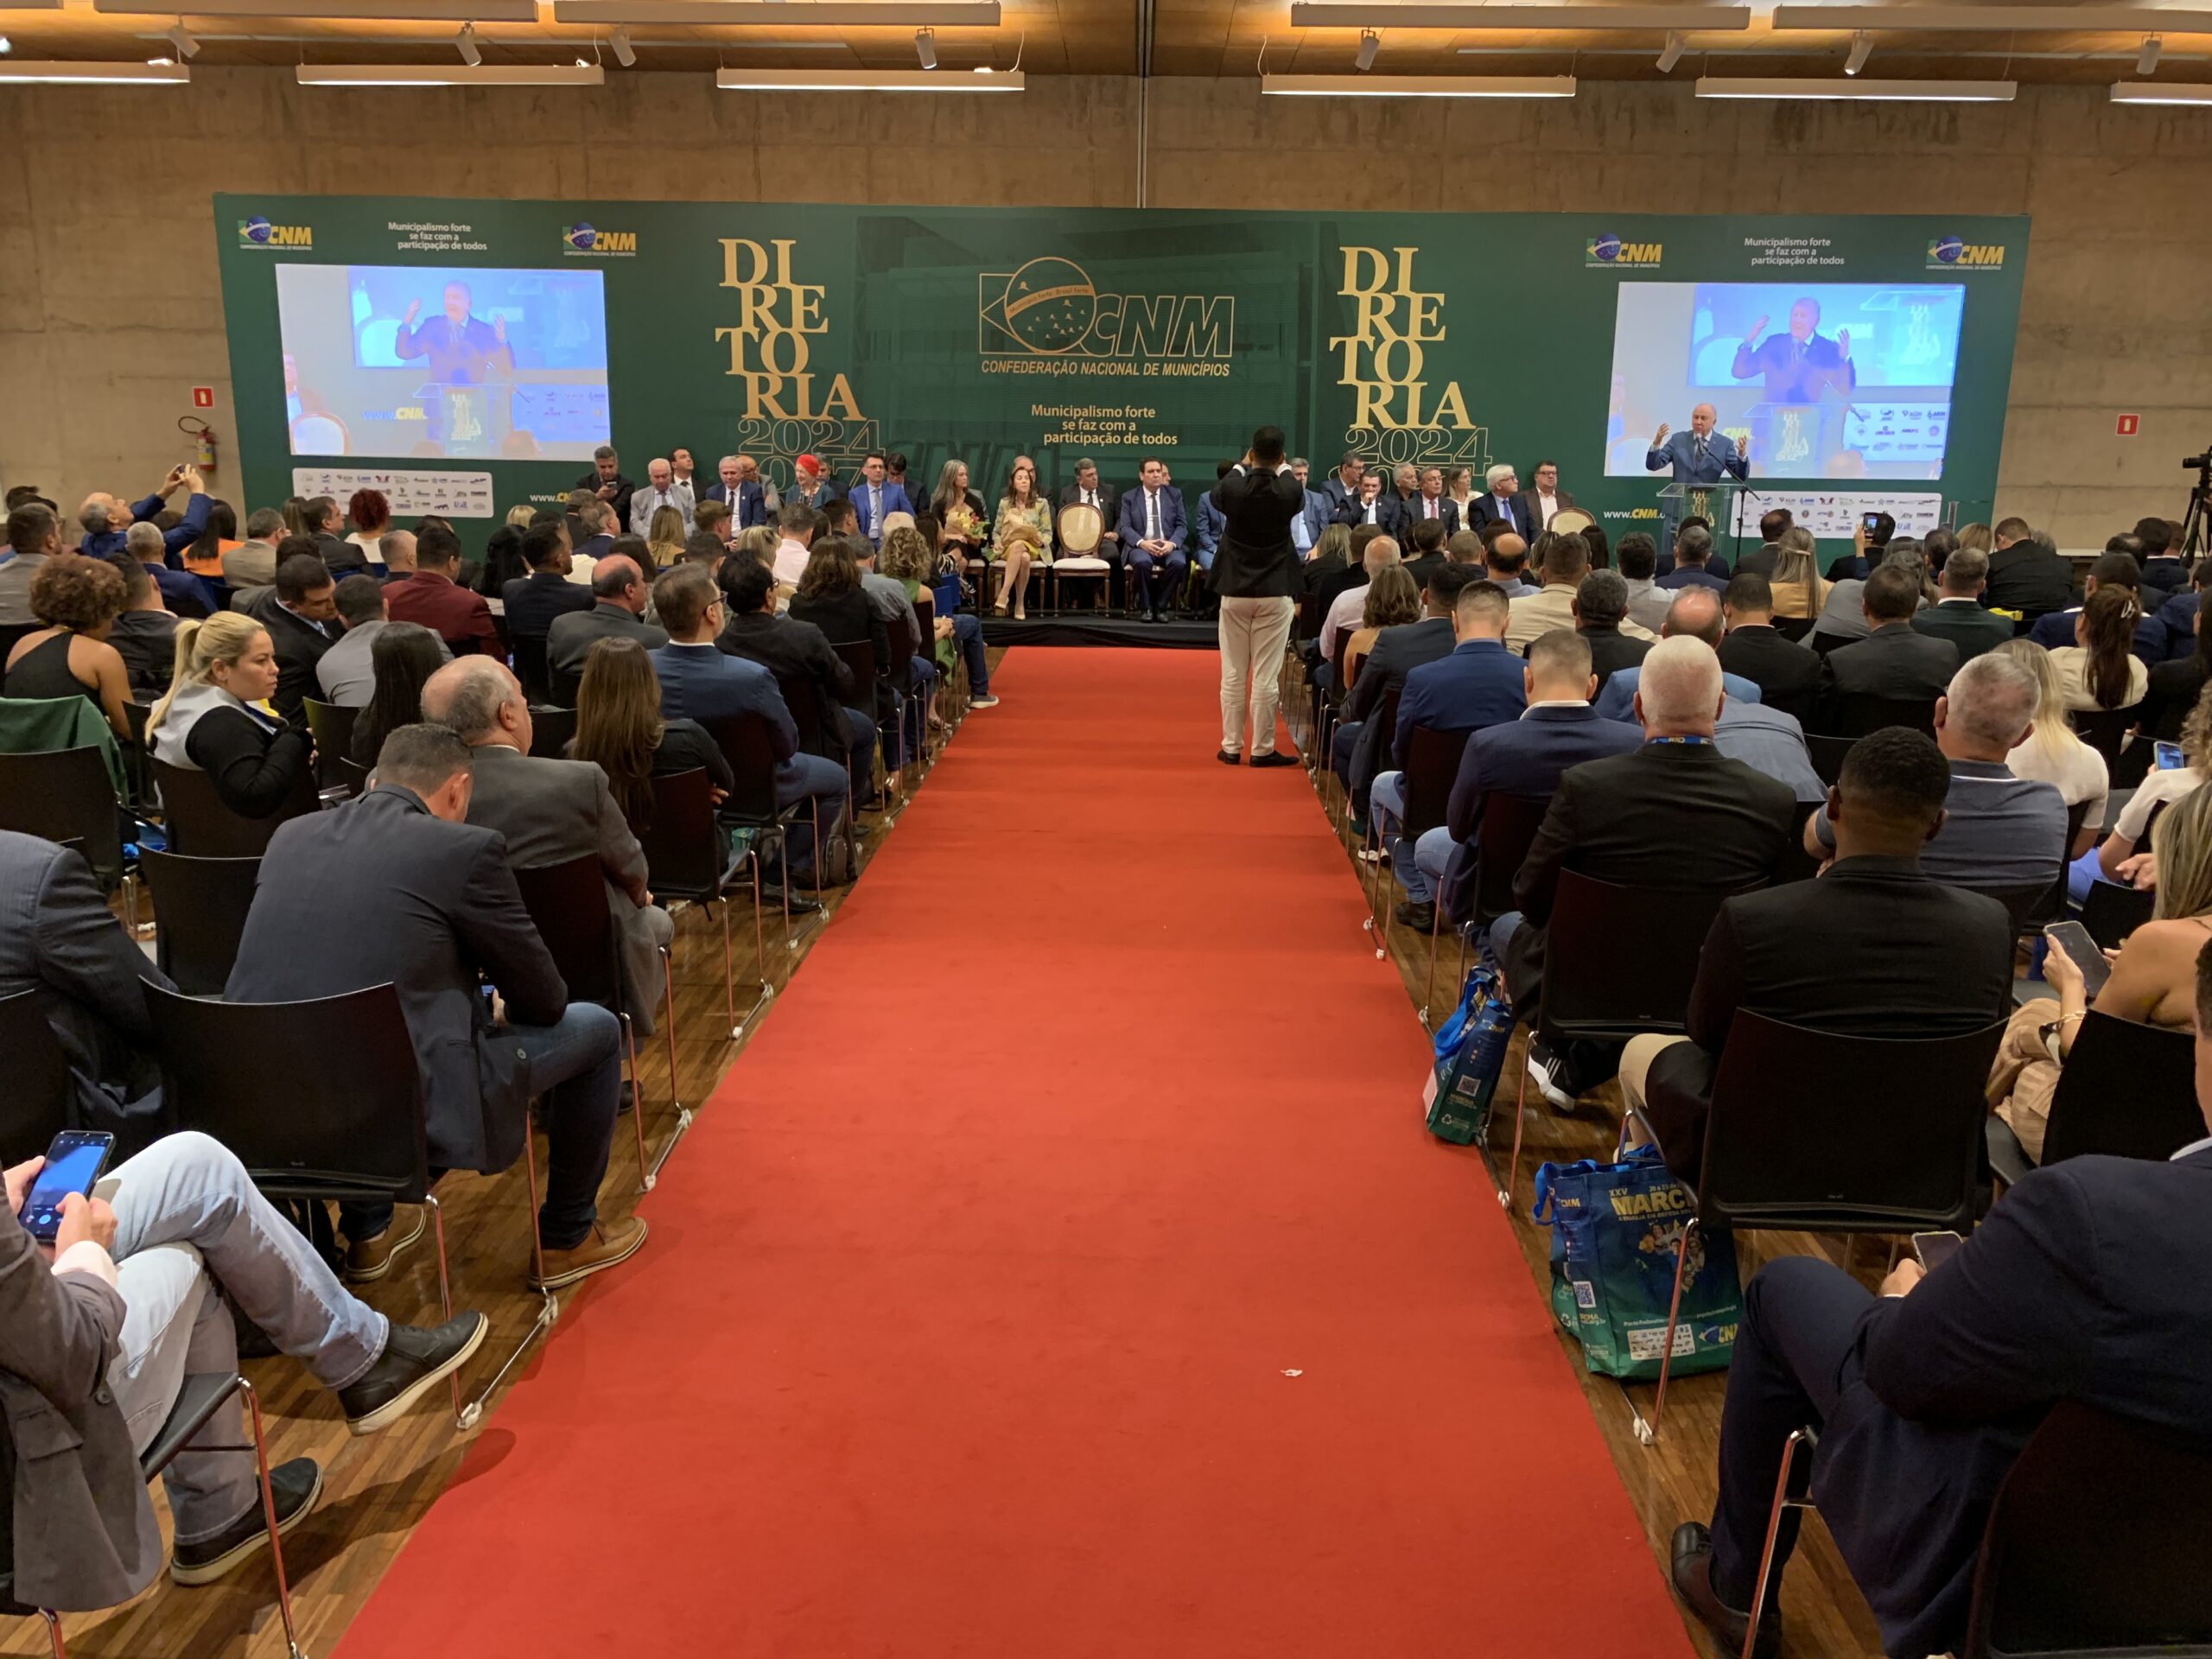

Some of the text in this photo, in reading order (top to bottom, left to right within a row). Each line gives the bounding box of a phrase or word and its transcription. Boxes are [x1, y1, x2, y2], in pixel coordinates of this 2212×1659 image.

[268, 226, 312, 245] CNM
[388, 222, 471, 232] Municipalismo forte
[420, 232, 433, 240] faz
[397, 241, 449, 251] participação
[463, 242, 487, 251] todos
[592, 232, 636, 251] CNM
[1744, 238, 1831, 248] Municipalismo forte
[1616, 243, 1662, 262] CNM
[1751, 256, 1845, 266] participação de todos
[1776, 247, 1789, 256] faz
[1957, 245, 2005, 264] CNM
[718, 238, 797, 287] DI
[1337, 246, 1419, 296] DI
[740, 283, 829, 334] RE
[1353, 292, 1446, 341] RE
[1080, 293, 1235, 357] CNM
[715, 327, 810, 377] TO
[1329, 336, 1424, 385] TO
[982, 359, 1230, 378] CONFEDERAÇÃO NACIONAL DE MUNICÍPIOS
[741, 372, 867, 422] RIA
[1350, 381, 1477, 429] RIA
[1031, 404, 1156, 420] Municipalismo forte
[1062, 419, 1136, 431] se faz com a
[738, 418, 887, 456] 2024
[1044, 432, 1178, 447] participação de todos
[1345, 427, 1493, 466] 2024
[1609, 1188, 1628, 1198] XXV
